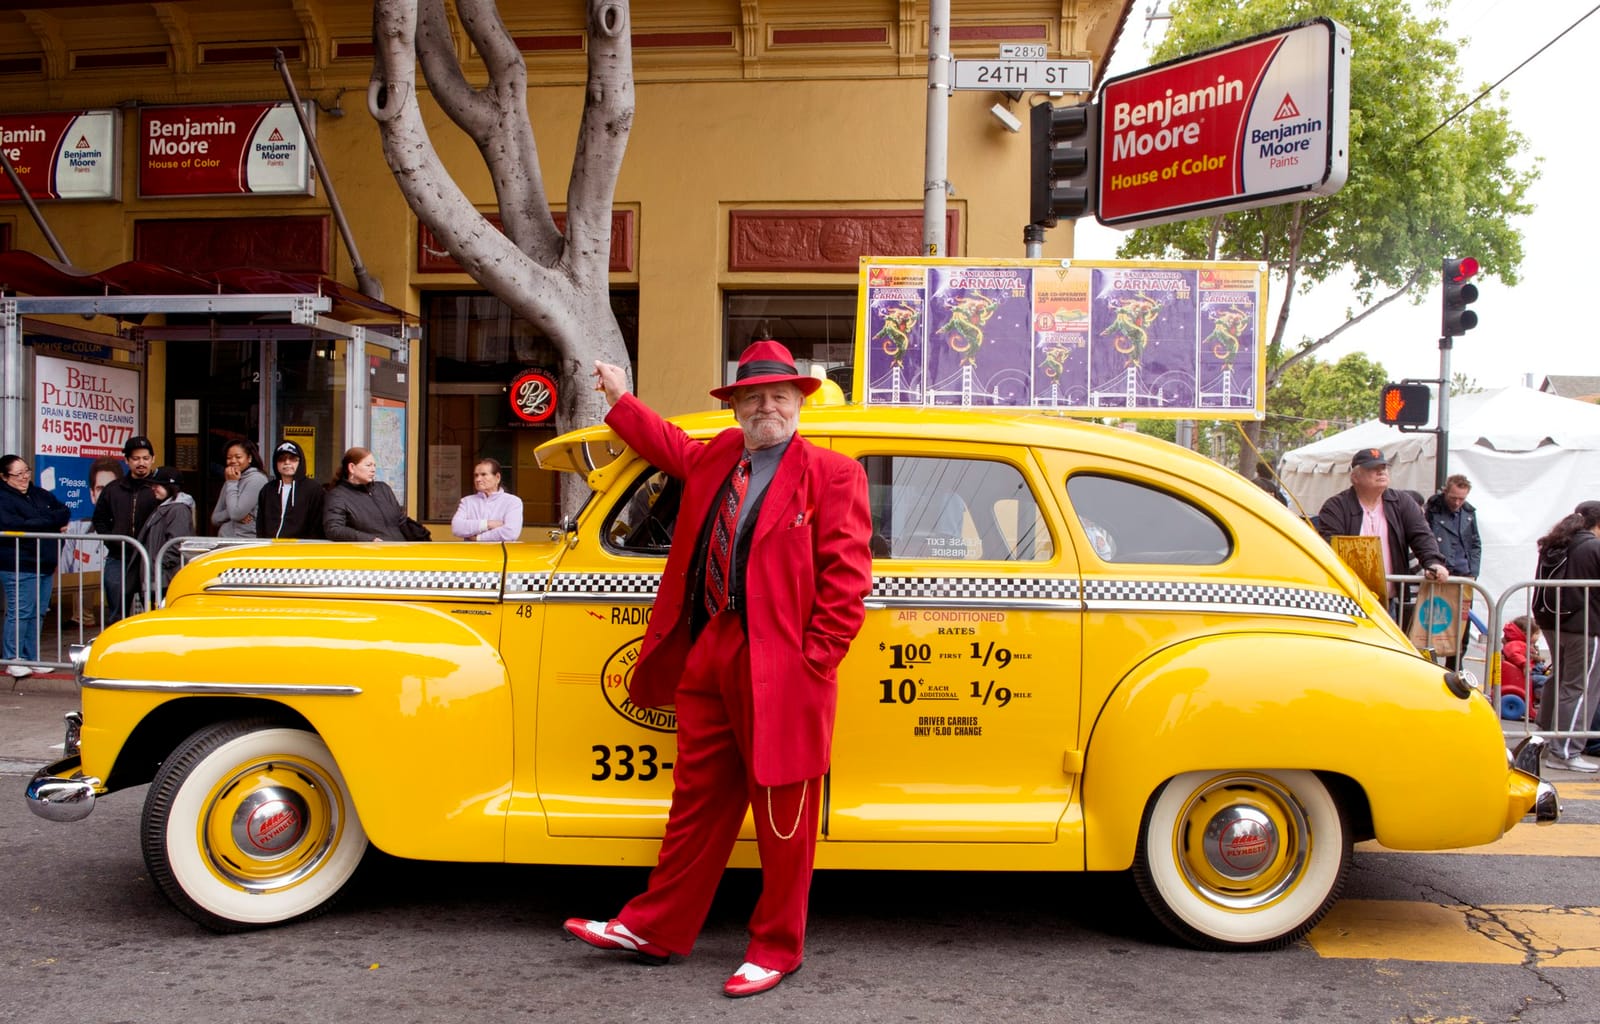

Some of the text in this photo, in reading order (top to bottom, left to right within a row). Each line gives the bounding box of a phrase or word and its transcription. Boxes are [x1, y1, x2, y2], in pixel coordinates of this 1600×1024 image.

[1014, 46, 1045, 57] 2850
[977, 66, 1068, 83] 24TH ST
[1113, 75, 1243, 132] Benjamin
[0, 125, 46, 146] jamin
[149, 117, 236, 140] Benjamin
[1251, 118, 1322, 144] Benjamin
[149, 138, 209, 155] Moore
[255, 142, 296, 152] Benjamin
[1112, 122, 1200, 162] Moore
[1259, 138, 1310, 159] Moore
[64, 149, 102, 160] Benjamin
[261, 151, 290, 160] Moore
[14, 165, 31, 174] olor
[69, 158, 96, 167] Moore
[148, 159, 220, 169] House of Color
[1269, 156, 1299, 169] Paints
[1111, 154, 1226, 191] House of Color
[949, 278, 1025, 289] CARNAVAL
[1113, 280, 1190, 291] CARNAVAL
[66, 366, 112, 393] BELL
[41, 382, 135, 414] PLUMBING
[41, 407, 134, 424] DRAIN & SEWER CLEANING
[42, 418, 134, 445] 415 550-0777
[41, 444, 52, 453] 24
[55, 445, 78, 455] HOUR
[66, 489, 80, 498] call
[515, 604, 533, 618] 48
[898, 611, 1005, 622] AIR CONDITIONED
[938, 627, 976, 635] RATES
[619, 647, 640, 666] YEL
[970, 641, 1012, 669] 1/9
[606, 674, 622, 688] 19
[970, 680, 1012, 708] 1/9
[619, 697, 678, 728] KLONDI
[918, 716, 978, 726] DRIVER CARRIES
[914, 726, 931, 736] ONLY
[954, 726, 982, 736] CHANGE
